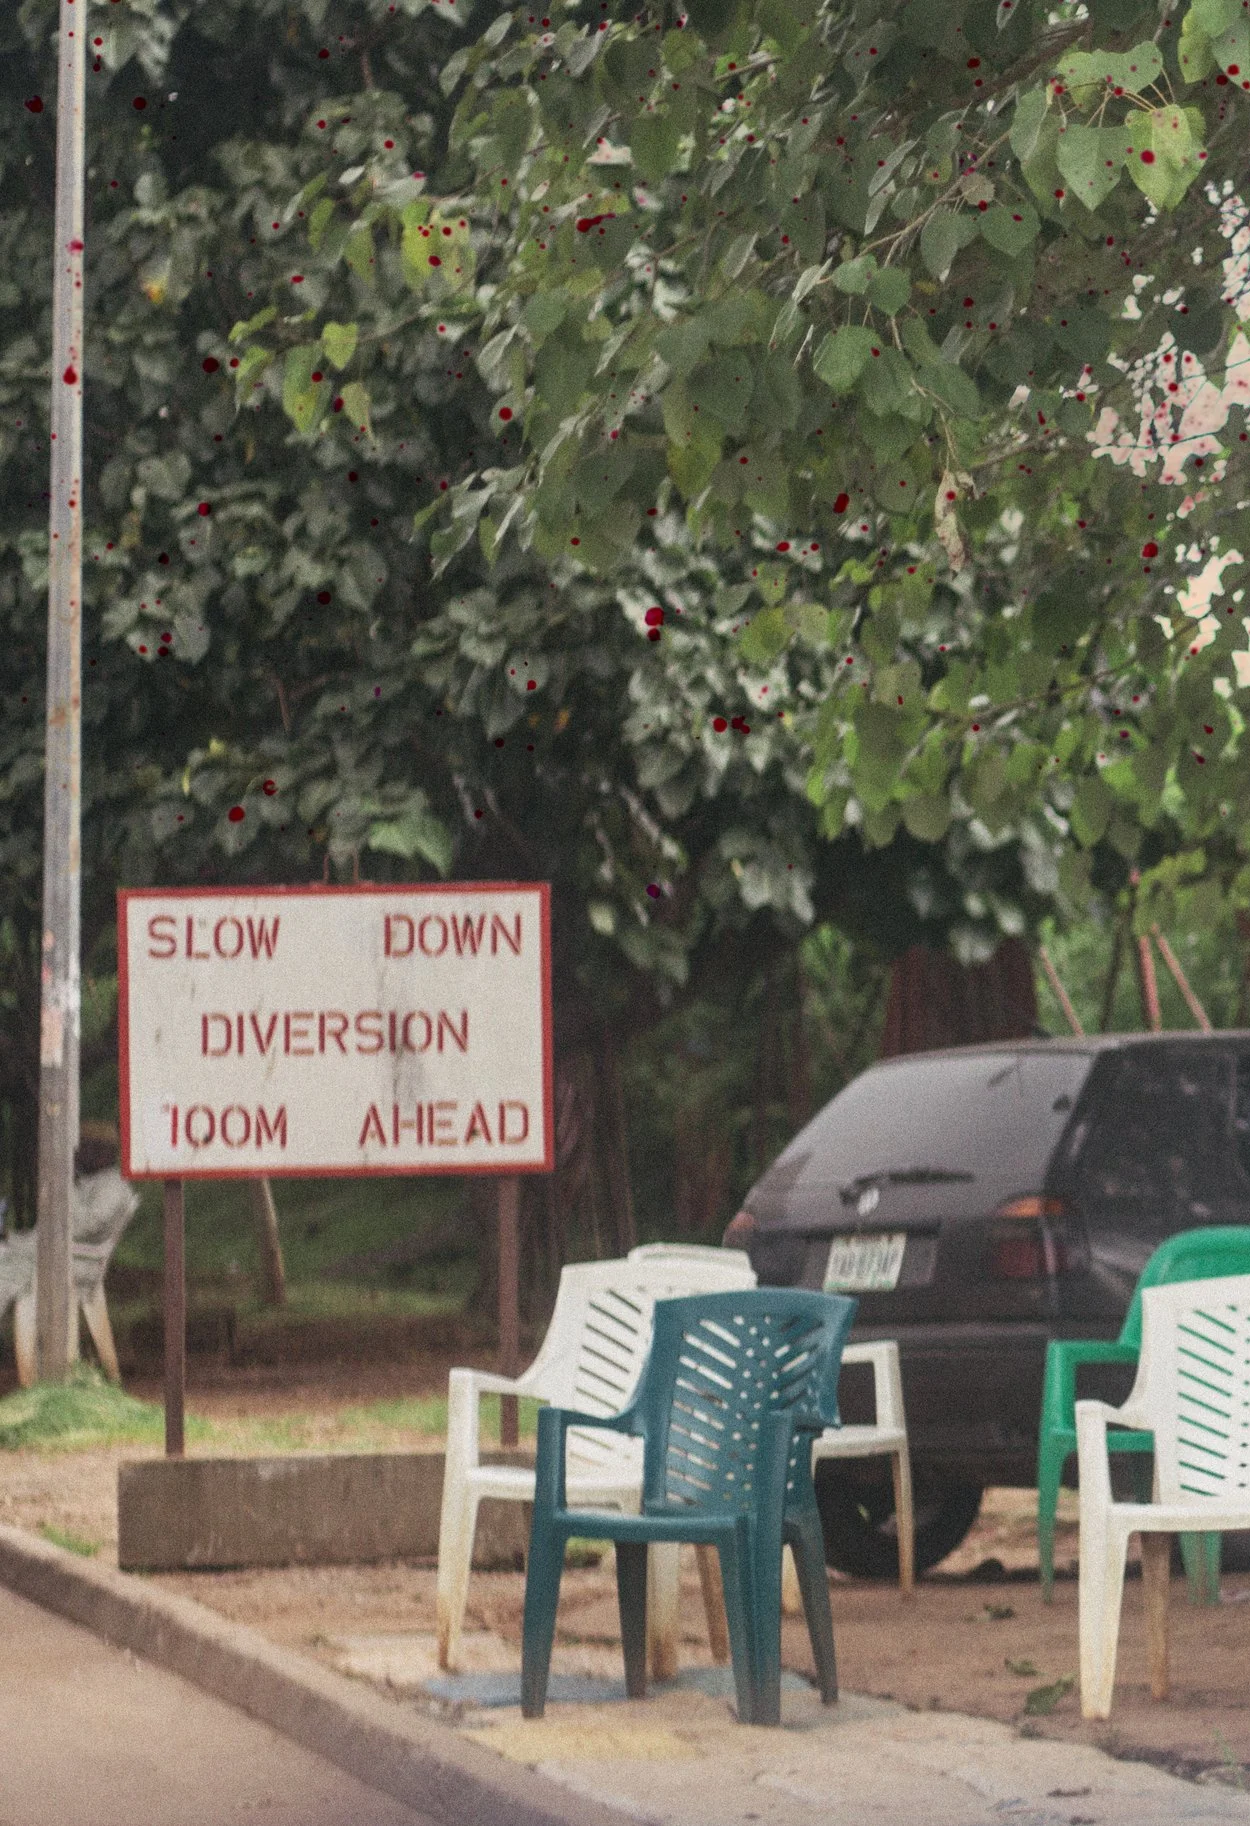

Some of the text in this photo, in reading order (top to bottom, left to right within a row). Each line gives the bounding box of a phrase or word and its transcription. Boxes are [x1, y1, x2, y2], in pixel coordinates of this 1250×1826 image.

[147, 911, 523, 960] SLOW DOWN
[201, 1008, 469, 1056] DIVERSION
[165, 1099, 529, 1150] 100M AHEAD
